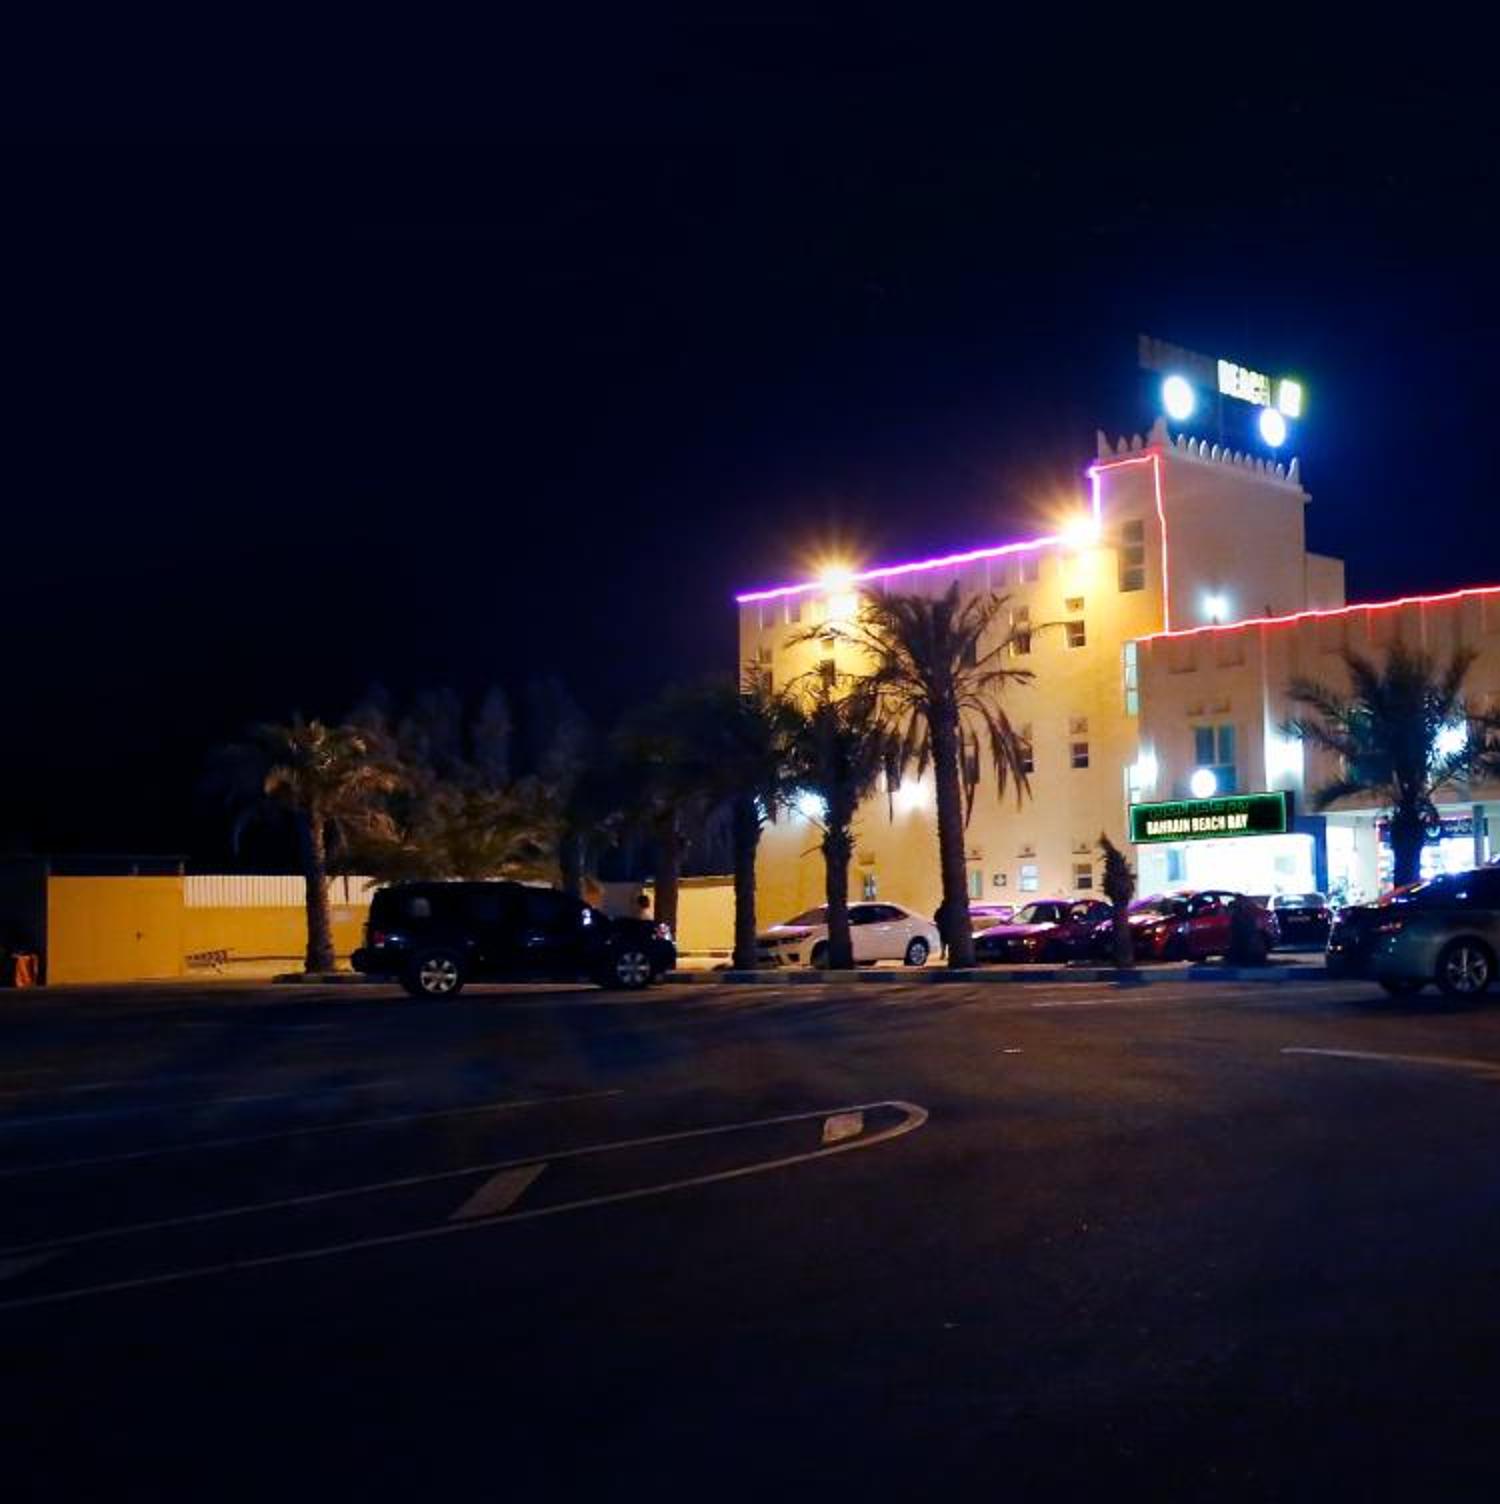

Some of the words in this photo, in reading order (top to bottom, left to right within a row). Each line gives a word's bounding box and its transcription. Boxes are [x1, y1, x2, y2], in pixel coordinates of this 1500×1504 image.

[1218, 360, 1270, 408] BEACH
[1147, 818, 1190, 835] BAHRAIN
[1192, 815, 1226, 832] BEACH
[1228, 813, 1249, 830] BAY
